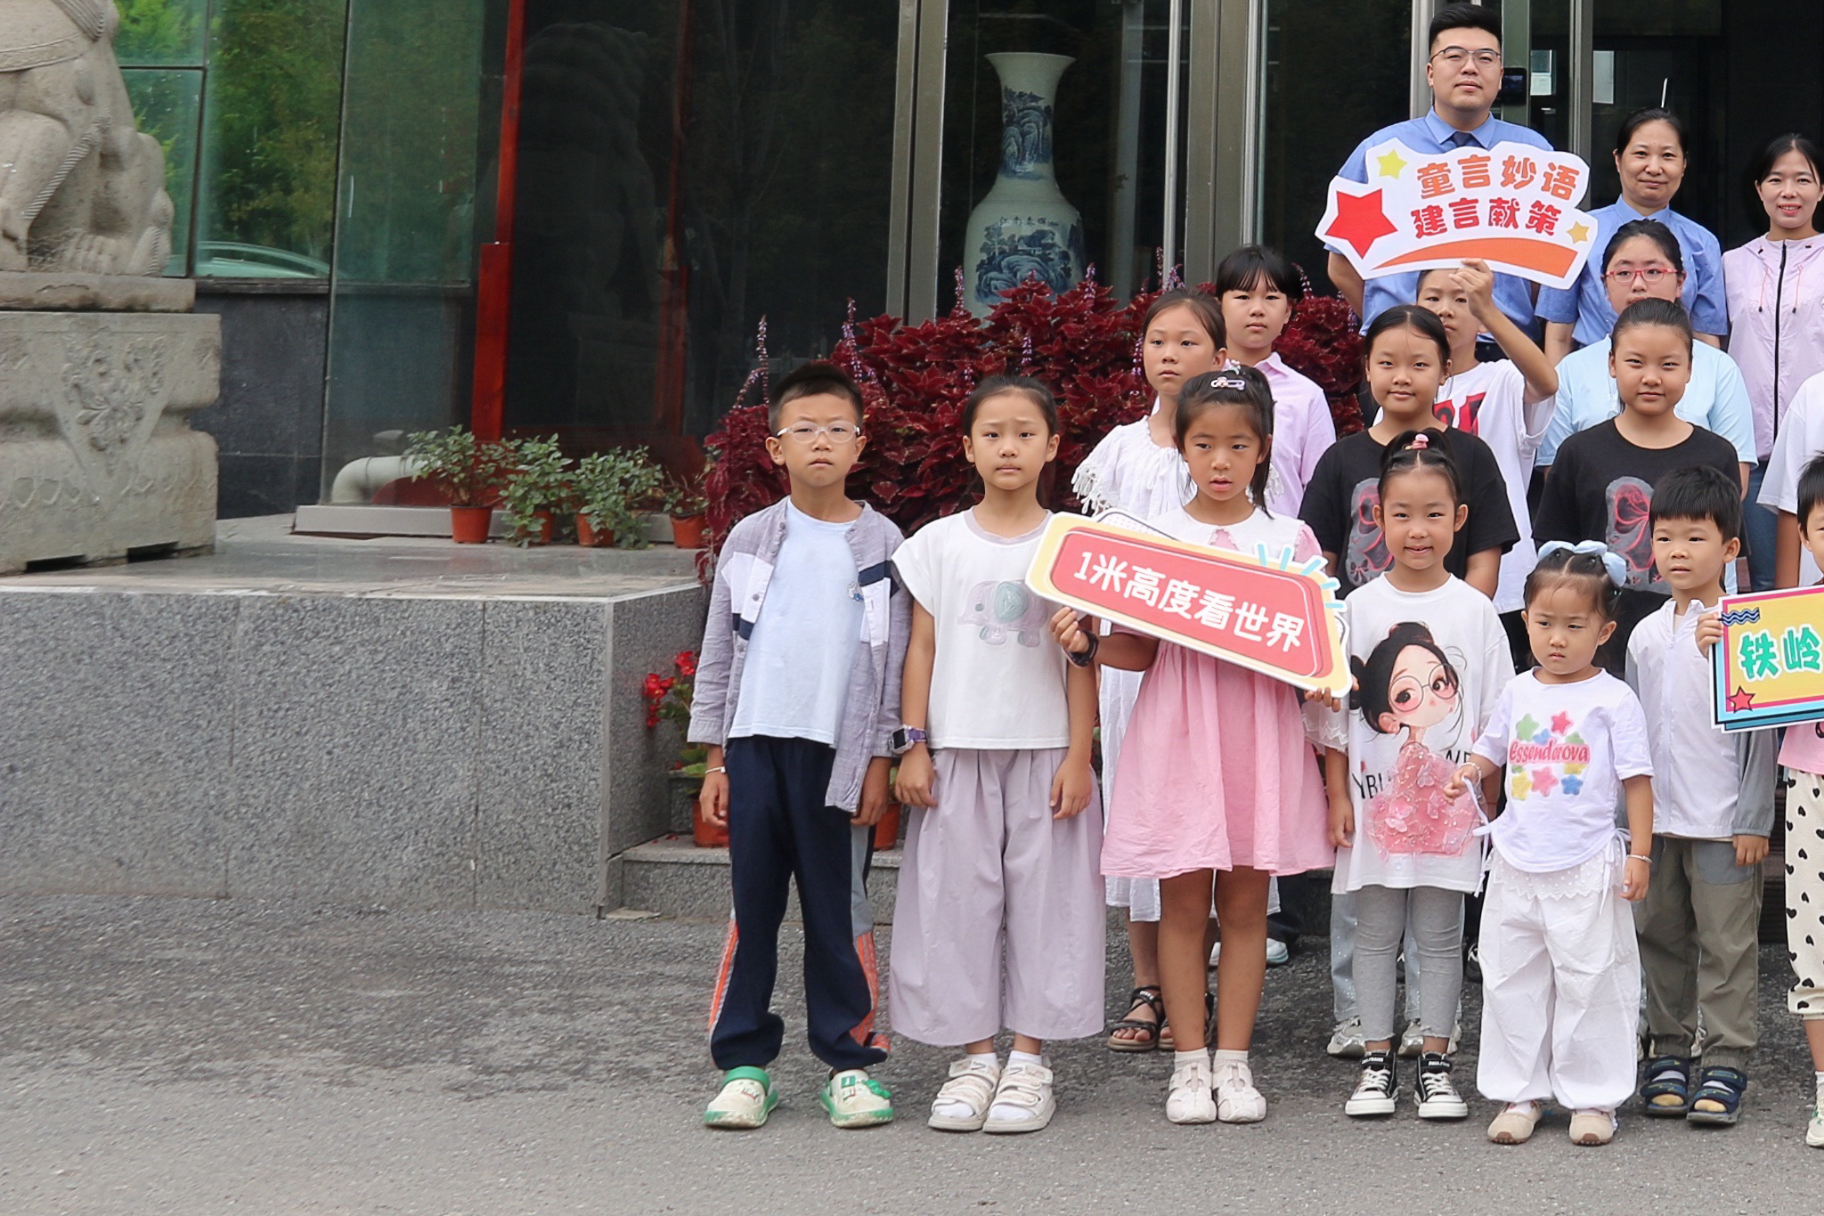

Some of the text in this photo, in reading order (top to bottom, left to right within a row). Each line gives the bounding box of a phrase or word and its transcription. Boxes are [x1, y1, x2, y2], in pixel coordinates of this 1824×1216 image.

[1416, 154, 1580, 201] 童言妙语
[1411, 197, 1562, 239] 建言献策
[1073, 551, 1306, 653] 1米高度看世界
